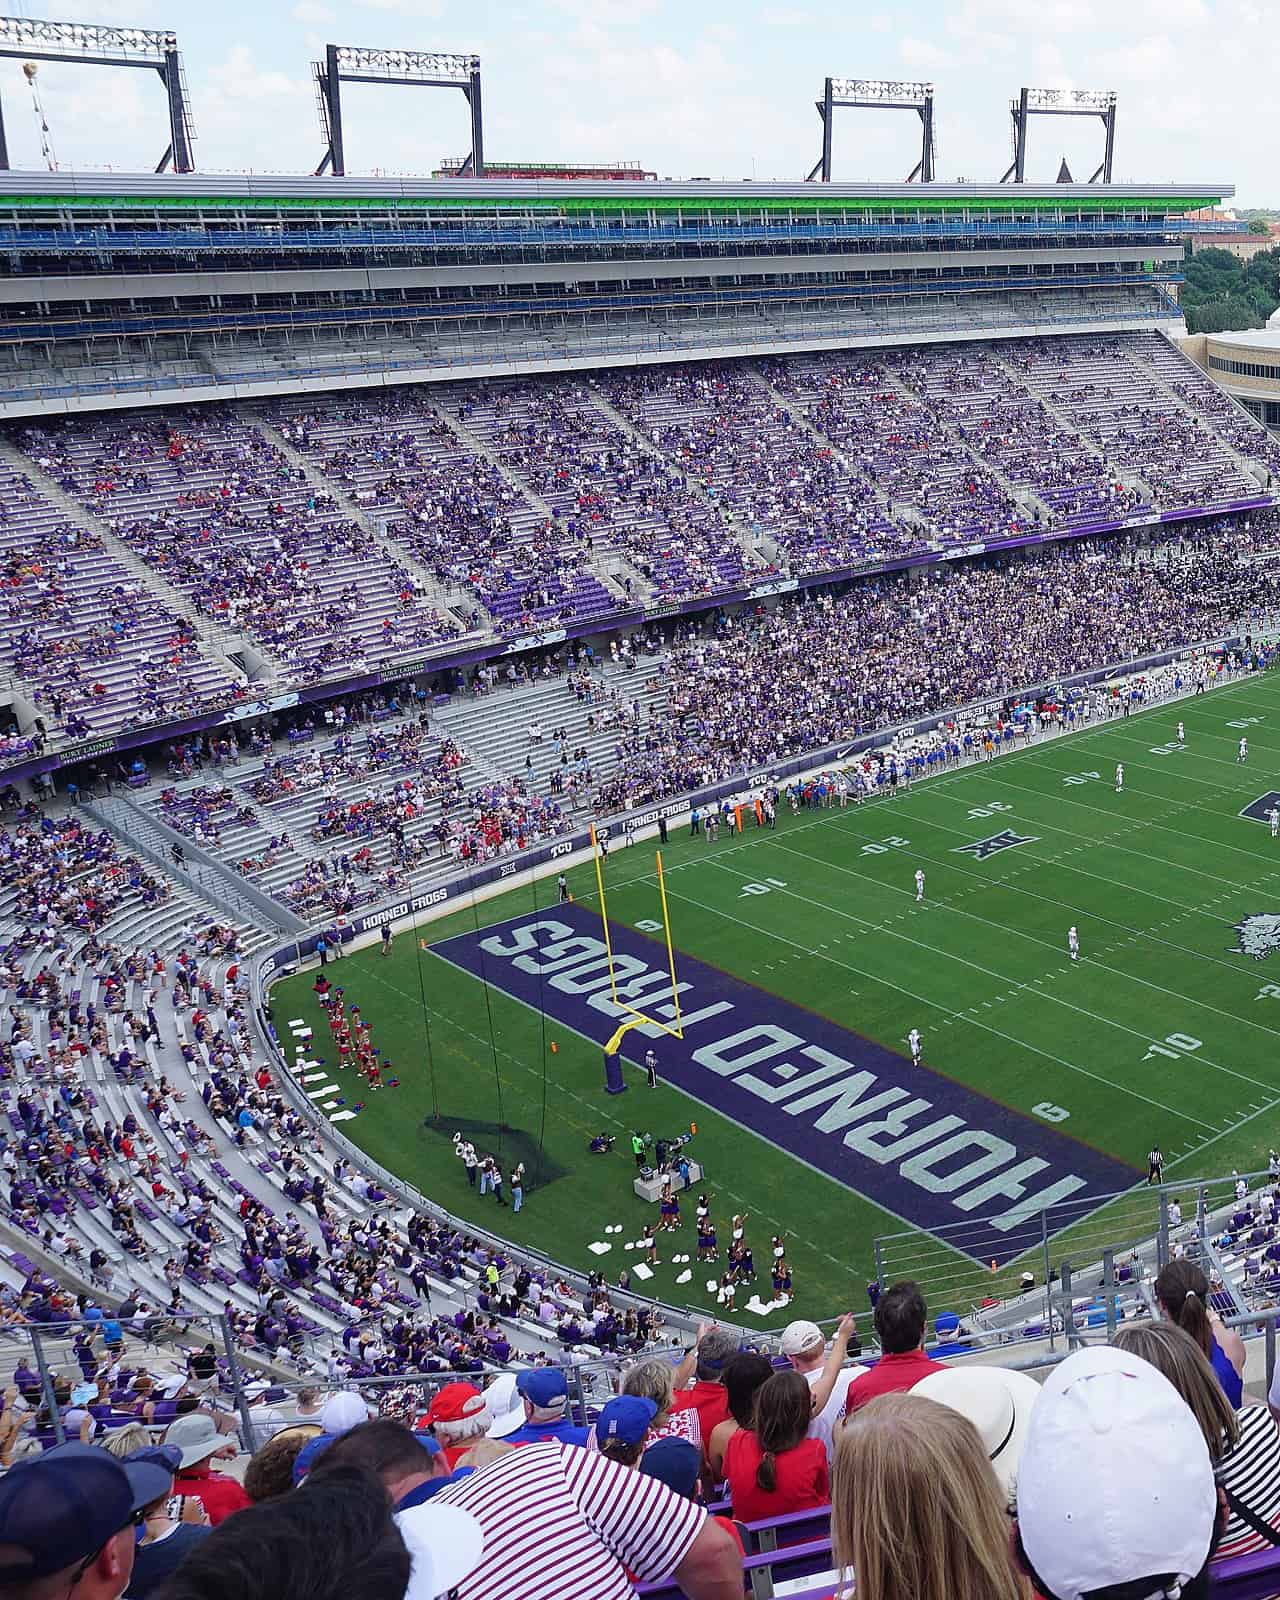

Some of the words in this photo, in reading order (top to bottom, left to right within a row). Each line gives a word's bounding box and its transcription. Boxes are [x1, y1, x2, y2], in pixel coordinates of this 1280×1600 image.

[1225, 715, 1262, 729] 40
[898, 727, 914, 739] TCU
[60, 750, 81, 760] BURT
[83, 740, 113, 753] LADNER
[1149, 743, 1190, 756] 50
[749, 774, 767, 788] TCU
[1067, 770, 1101, 785] 40
[660, 800, 691, 817] FROGS
[969, 801, 1014, 818] 30
[551, 842, 572, 858] TCU
[863, 835, 911, 855] 20
[742, 877, 788, 895] 10
[362, 903, 409, 931] HORNED
[412, 887, 448, 913] FROGS
[479, 920, 735, 1039] FROGS
[1149, 1032, 1203, 1060] 10
[1032, 1101, 1071, 1123] G
[691, 1024, 1087, 1232] HORNED
